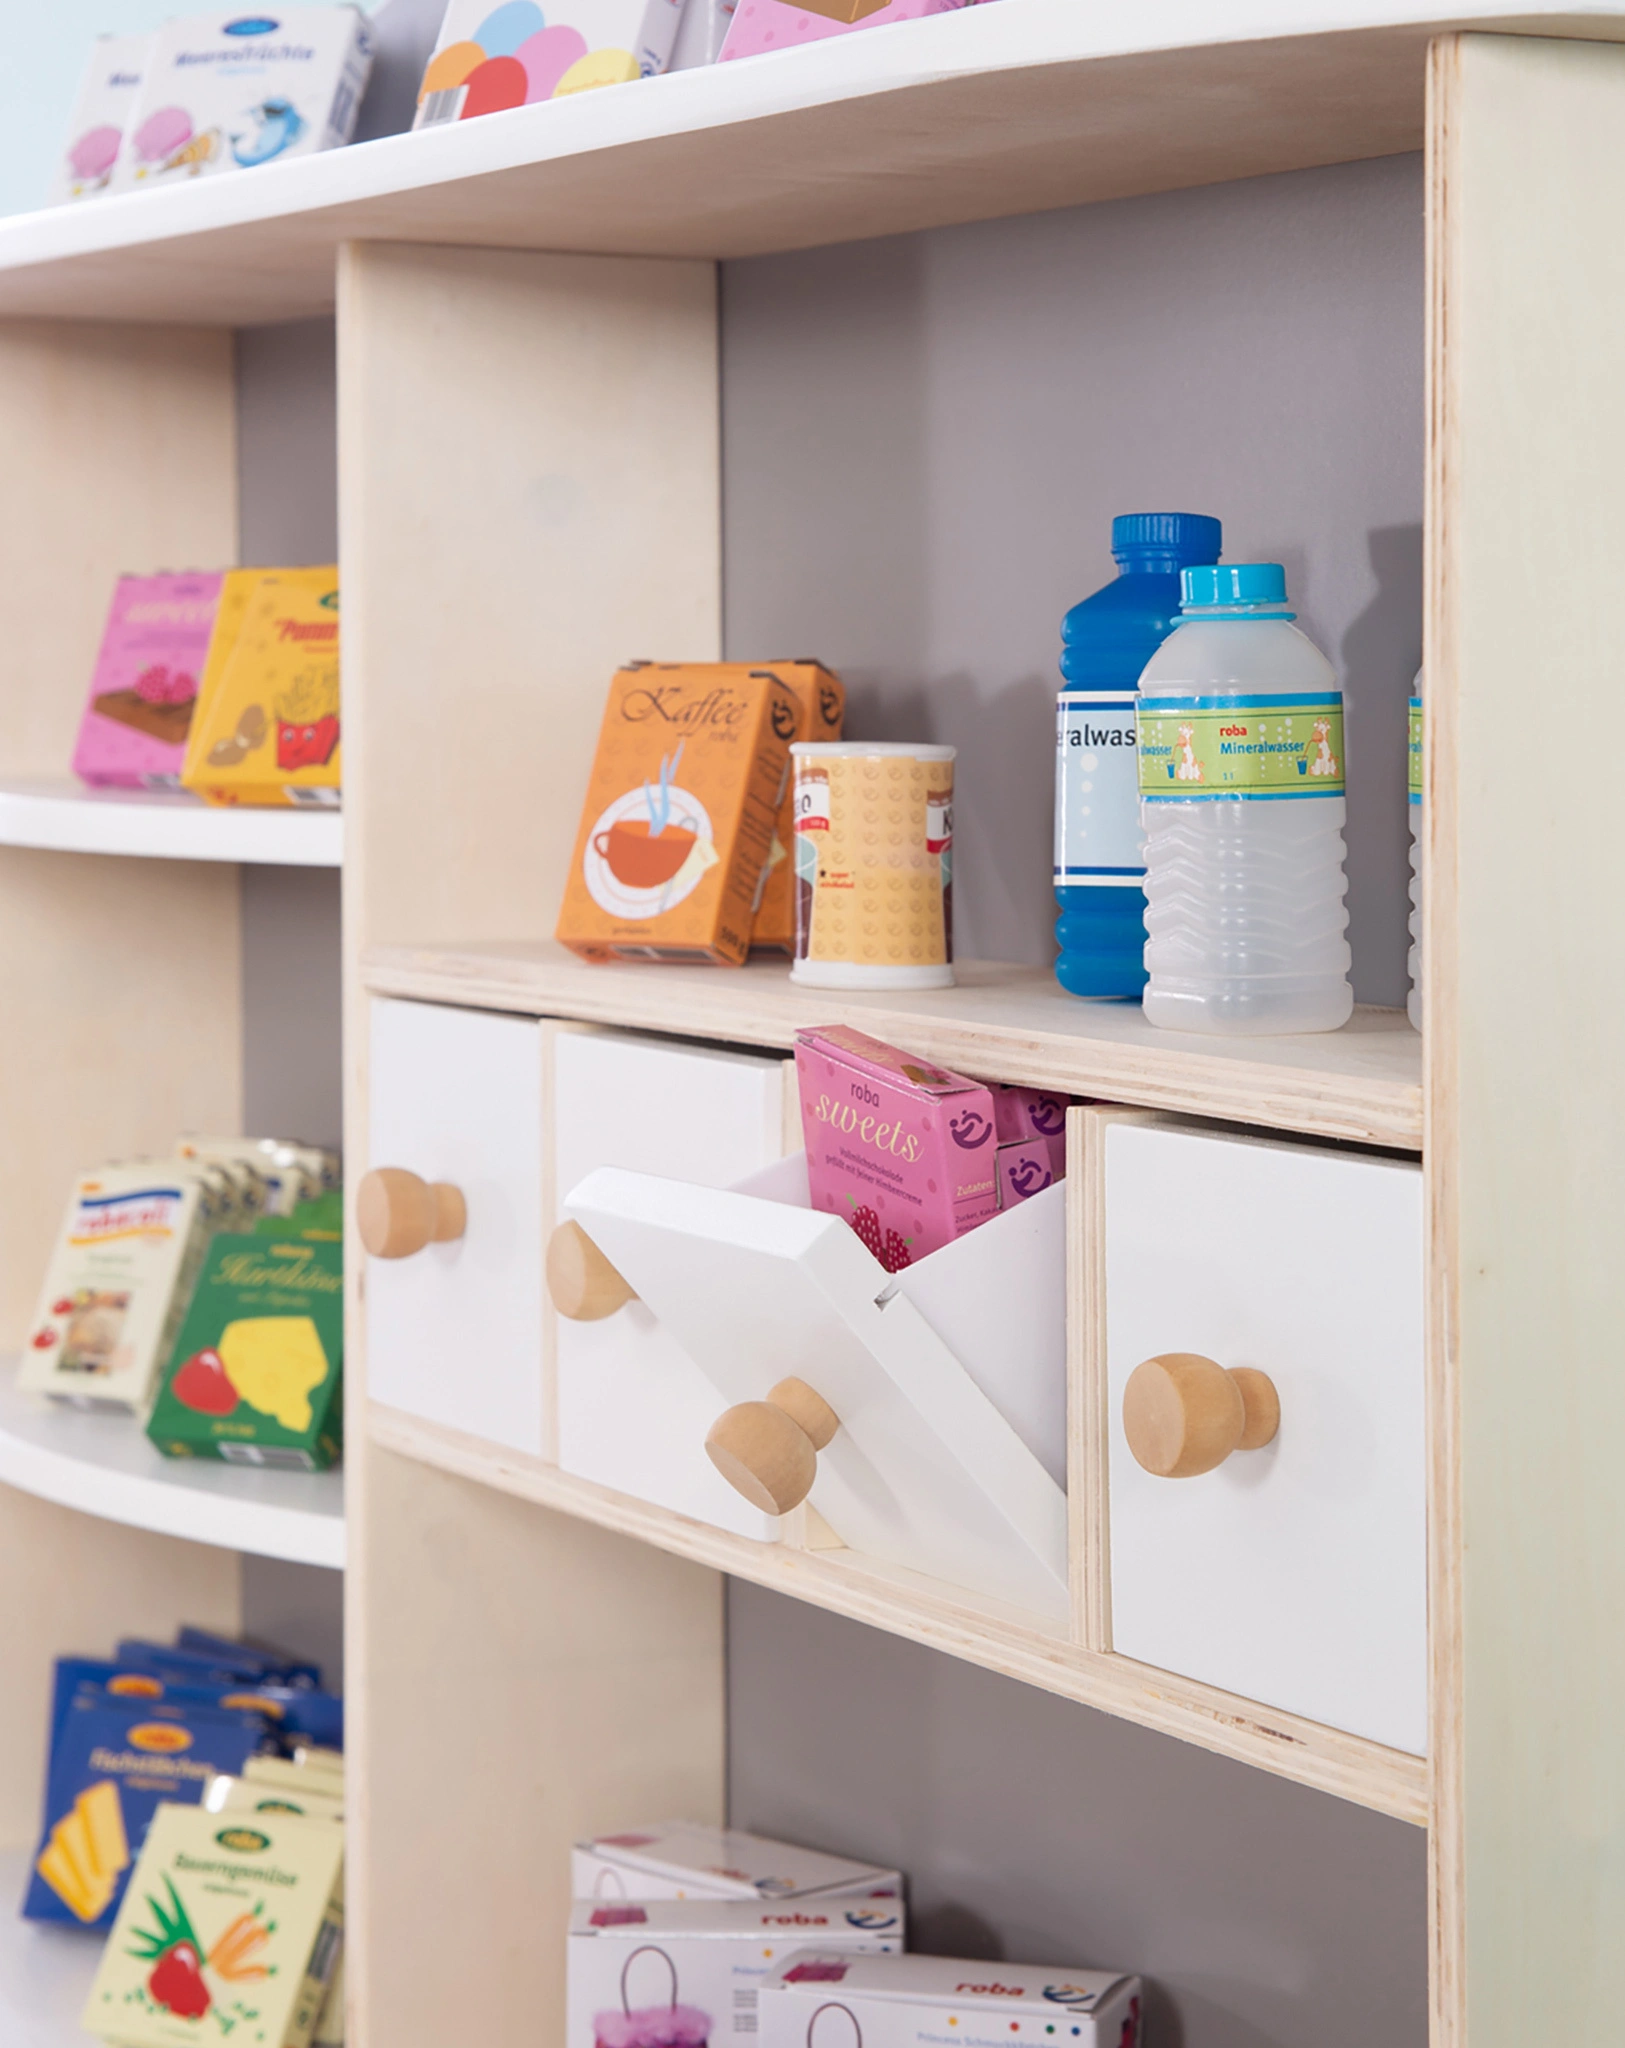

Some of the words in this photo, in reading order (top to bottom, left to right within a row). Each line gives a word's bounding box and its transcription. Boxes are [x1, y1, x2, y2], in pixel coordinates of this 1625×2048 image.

[620, 686, 748, 738] Kaffee
[1219, 724, 1247, 737] roba
[1220, 741, 1305, 754] Mineralwasser
[850, 1082, 880, 1109] roba
[815, 1093, 925, 1163] sweets
[761, 1911, 829, 1926] roba
[955, 1983, 1026, 1997] roba
